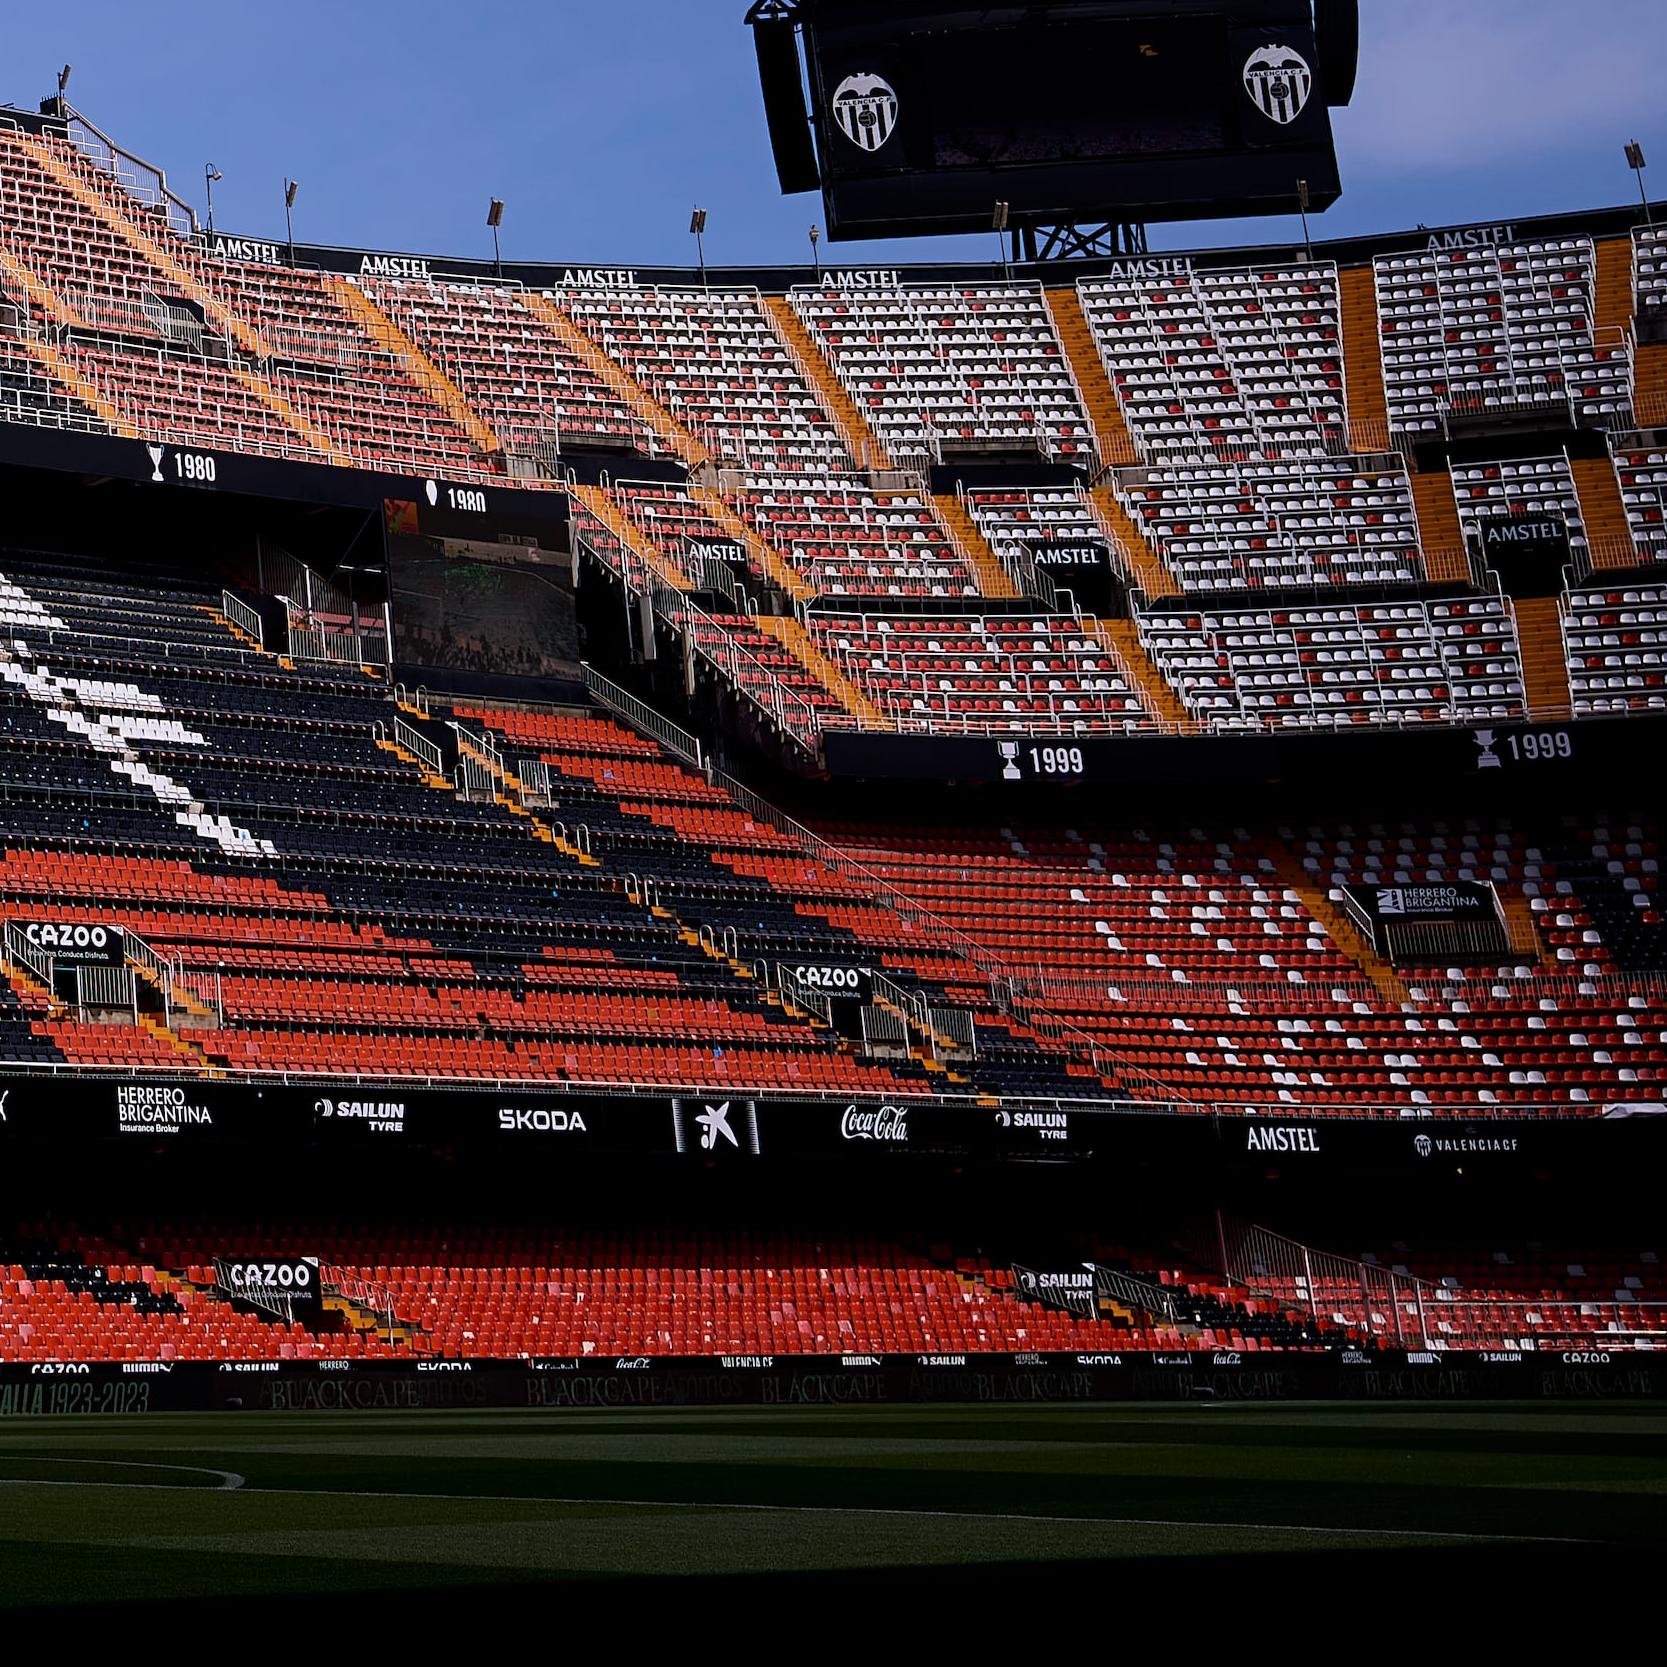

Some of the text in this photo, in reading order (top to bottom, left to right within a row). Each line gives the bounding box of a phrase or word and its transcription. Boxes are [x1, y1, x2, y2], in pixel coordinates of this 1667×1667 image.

[1426, 225, 1520, 253] AMSTEL
[214, 237, 281, 265] AMSTEL
[361, 255, 431, 279] AMSTEL
[1109, 258, 1198, 279] AMSTEL
[562, 270, 640, 289] AMSTEL
[820, 271, 903, 290] AMSTEL
[174, 452, 216, 482] 1980
[447, 488, 487, 513] 1980
[1489, 522, 1562, 543] AMSTEL
[689, 543, 746, 562] AMSTEL
[1034, 548, 1100, 564] AMSTEL
[1507, 731, 1572, 760] 1999
[1029, 747, 1083, 773] 1999
[1403, 887, 1457, 899] HERRERO
[1406, 896, 1480, 907] BRIGANTINA
[26, 924, 107, 947] CAZOO
[796, 966, 858, 988] CAZOO
[117, 1086, 185, 1106] HERRERO
[118, 1104, 213, 1124] BRIGANTINA
[337, 1102, 405, 1119] SAILUN
[1013, 1113, 1067, 1128] SAILUN
[119, 1123, 180, 1133] Insurance Broker
[368, 1121, 404, 1132] TYRE
[841, 1104, 909, 1141] Coca-Cola
[1038, 1130, 1068, 1140] TYRE
[1247, 1127, 1320, 1152] AMSTEL
[231, 1264, 310, 1287] CAZOO
[1039, 1273, 1093, 1288] SAILUN
[929, 1356, 966, 1366] SAILUN
[1489, 1352, 1522, 1362] SAILUN
[1562, 1353, 1610, 1364] CAZOO
[46, 1380, 150, 1414] 1923-2023
